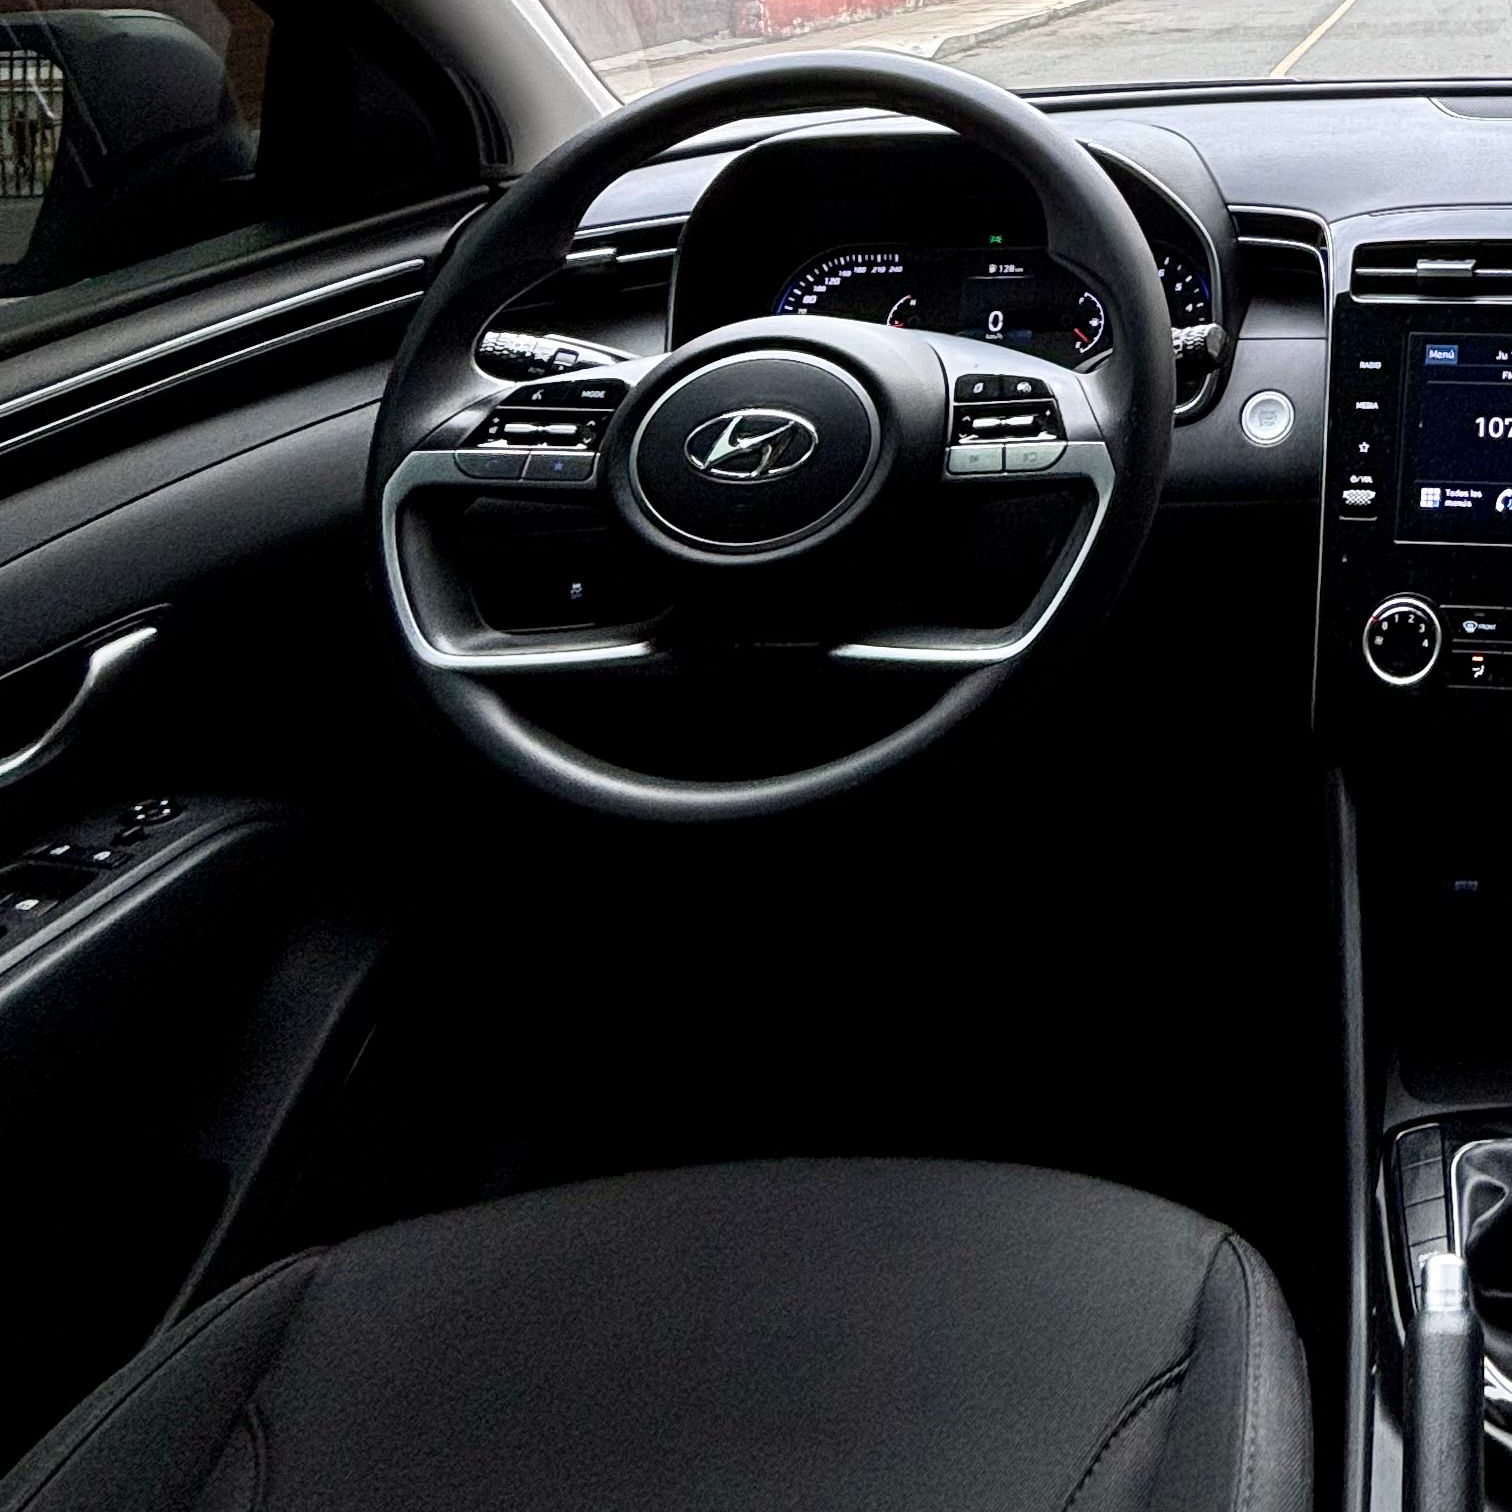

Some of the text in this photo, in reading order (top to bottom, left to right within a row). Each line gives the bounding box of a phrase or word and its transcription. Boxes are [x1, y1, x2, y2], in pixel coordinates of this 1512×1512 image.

[988, 310, 1004, 332] 0
[1429, 349, 1455, 359] Menú
[581, 390, 606, 399] MODE
[1394, 614, 1399, 623] 1
[1408, 614, 1415, 624] 2
[1382, 621, 1389, 631] 0
[1418, 623, 1425, 633] 3
[1422, 639, 1429, 648] 4
